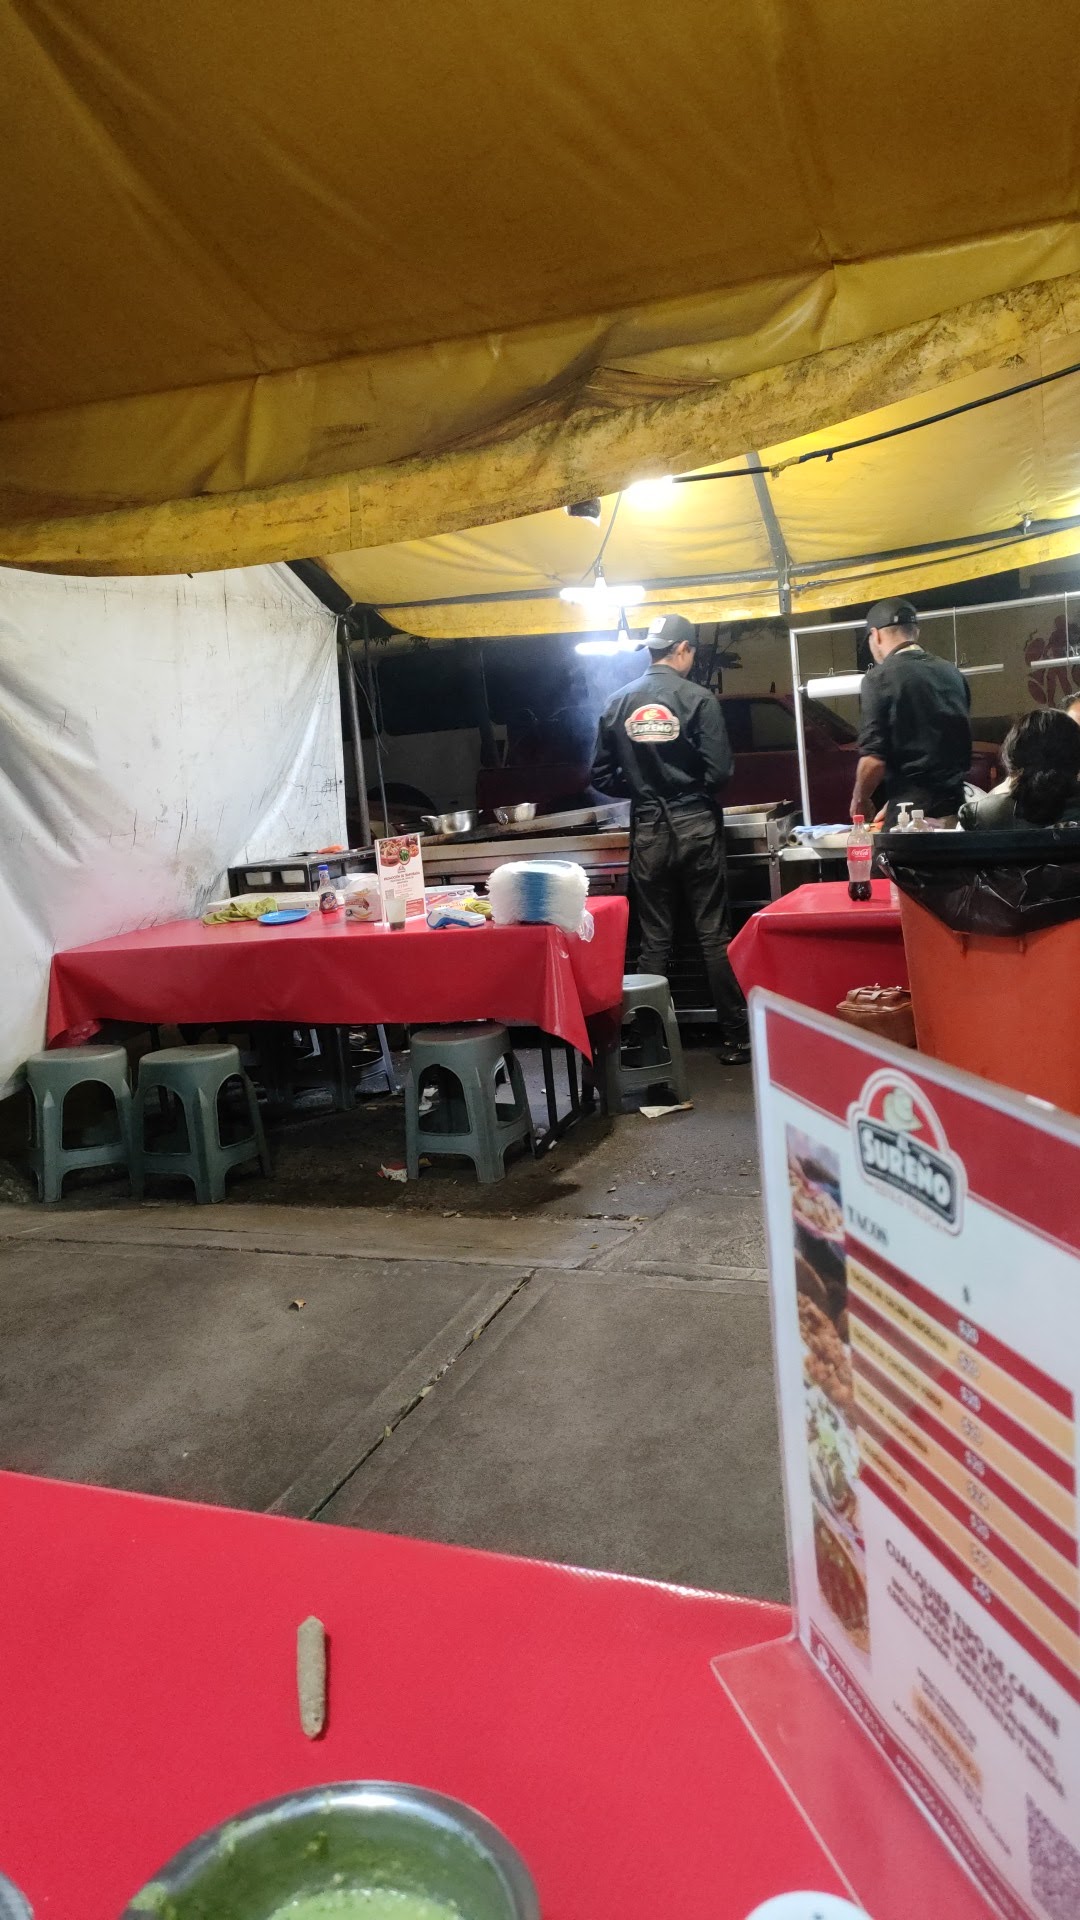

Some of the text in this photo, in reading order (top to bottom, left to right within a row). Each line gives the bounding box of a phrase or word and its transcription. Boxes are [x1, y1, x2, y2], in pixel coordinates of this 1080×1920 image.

[862, 1128, 950, 1206] SUREÑO
[886, 1538, 950, 1617] CUALQUIER
[1009, 1673, 1060, 1738] CARNE
